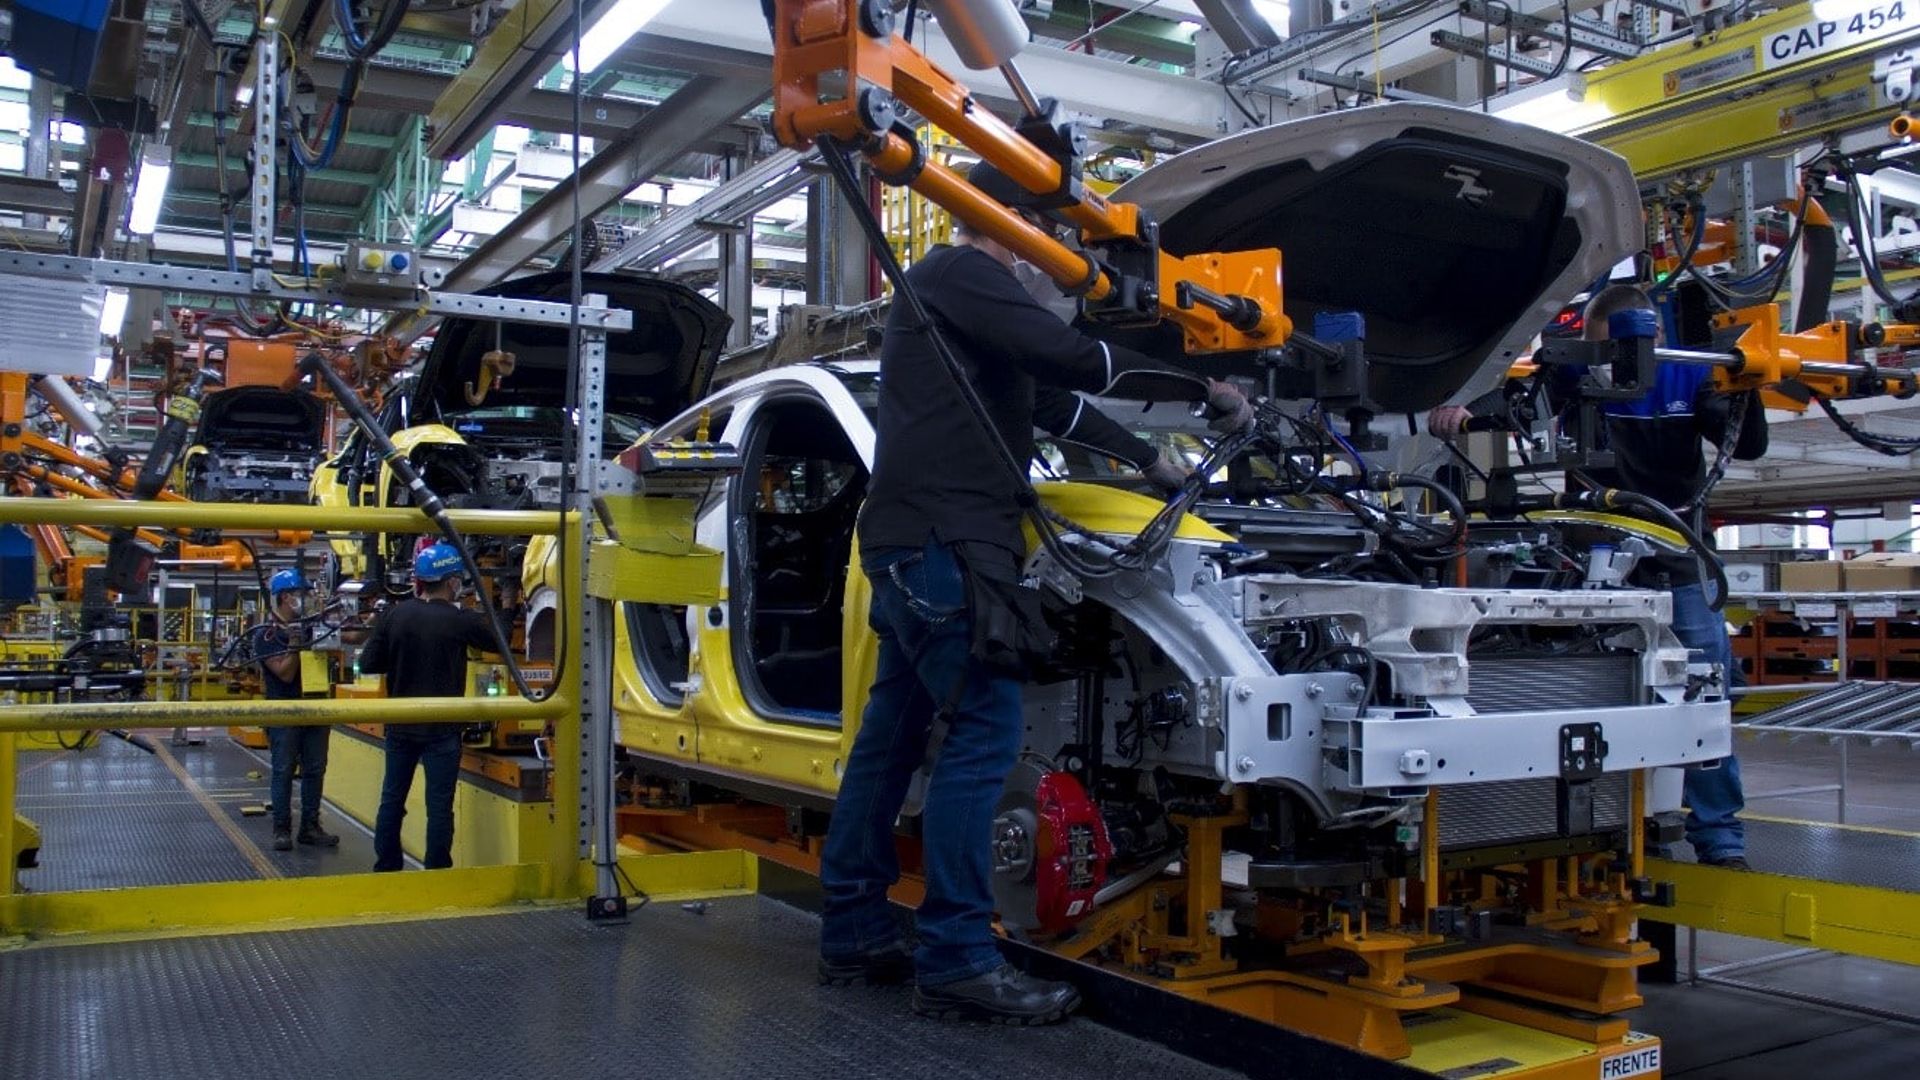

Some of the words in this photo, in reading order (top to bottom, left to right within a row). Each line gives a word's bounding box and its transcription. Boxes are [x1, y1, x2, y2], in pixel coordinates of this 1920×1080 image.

[1771, 21, 1836, 60] CAP
[1847, 1, 1906, 35] 454
[1603, 1049, 1658, 1079] FRENTE
